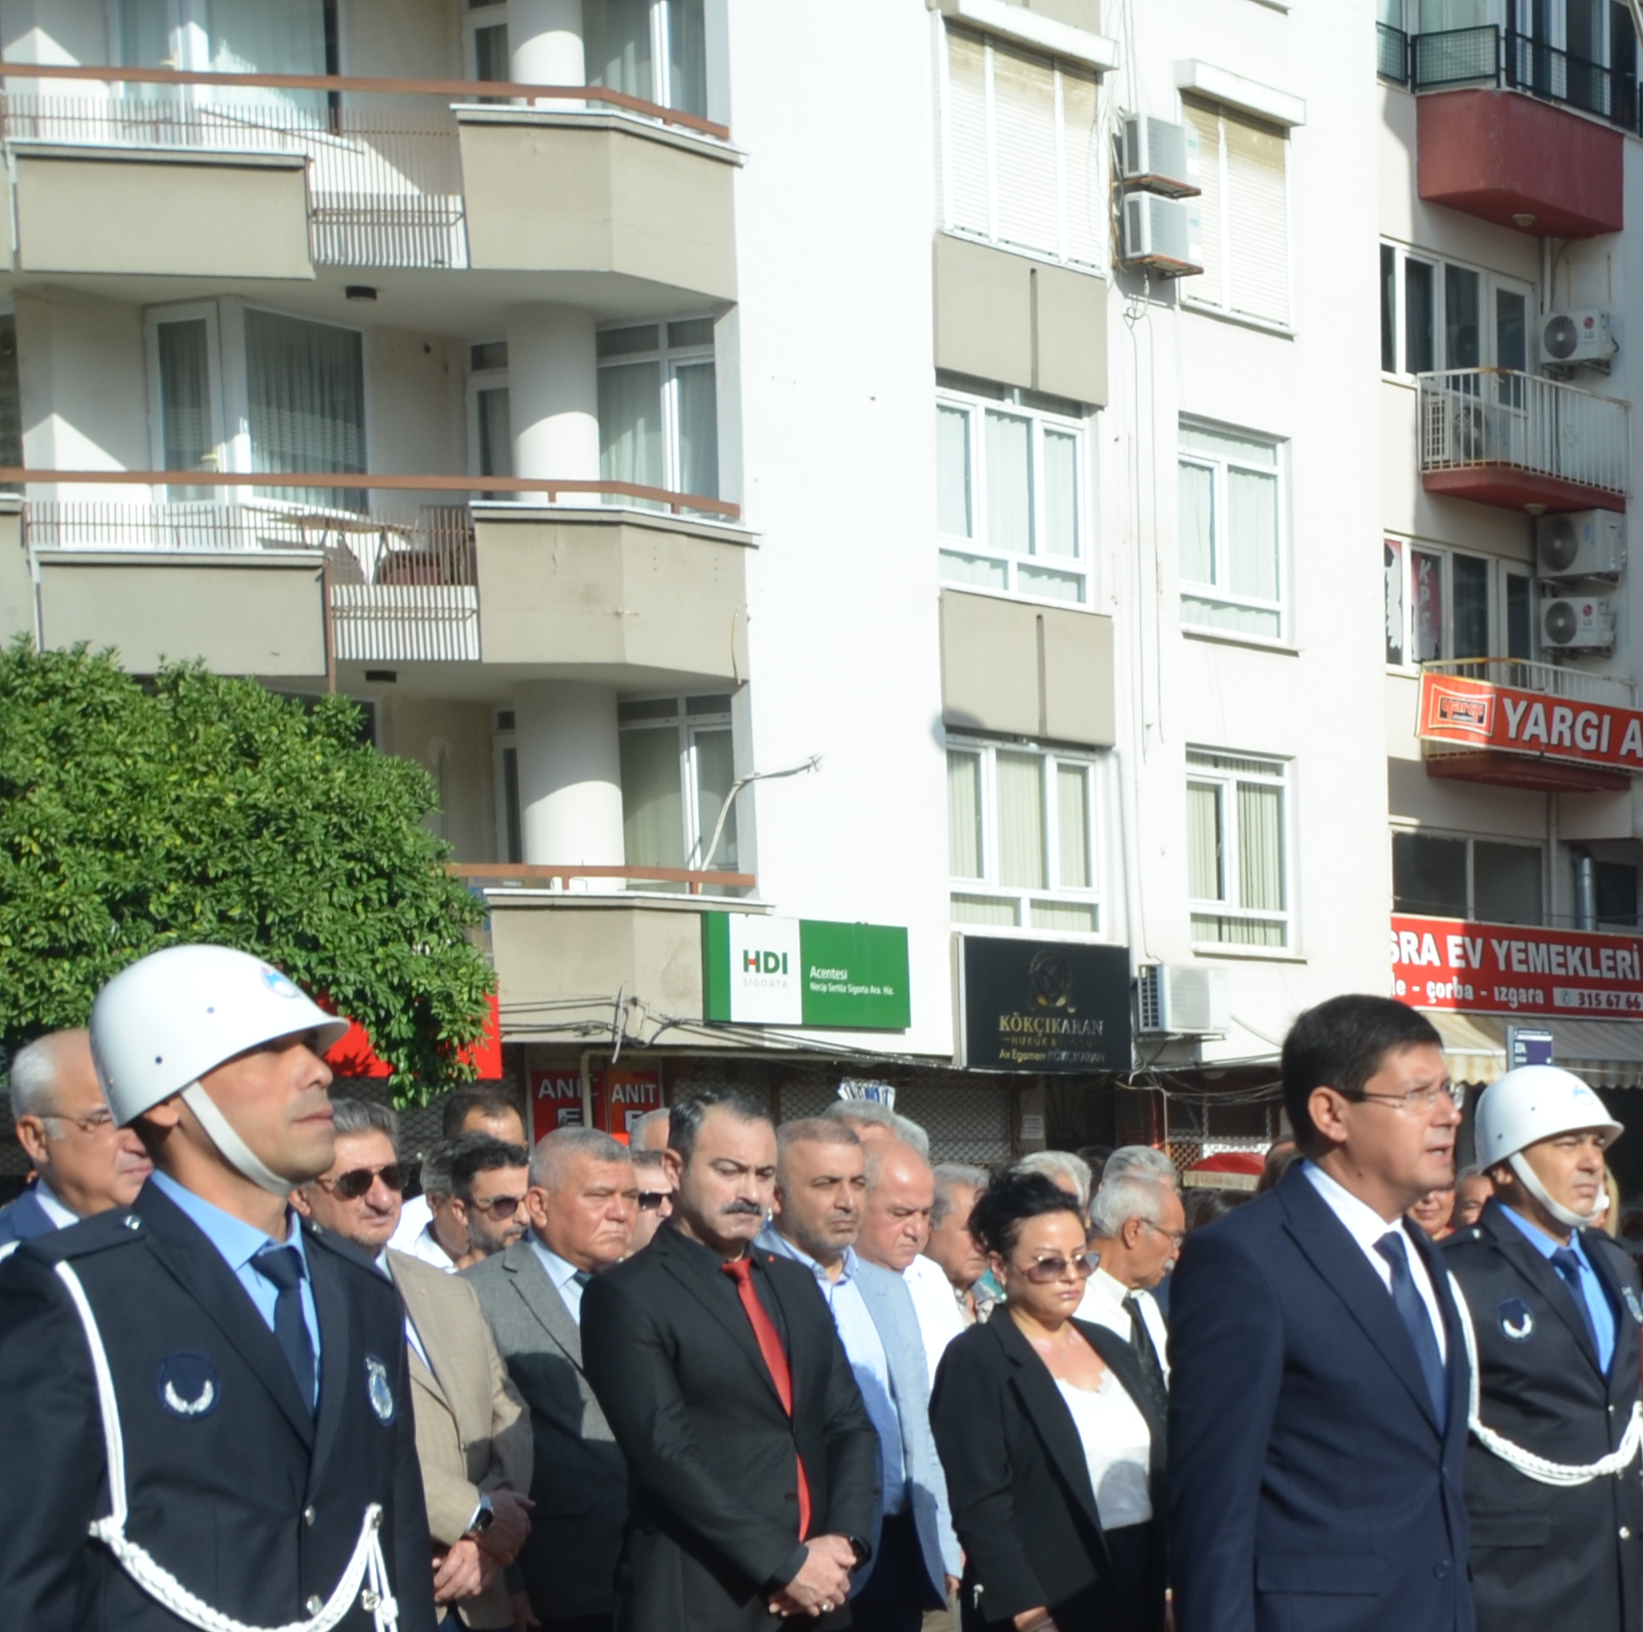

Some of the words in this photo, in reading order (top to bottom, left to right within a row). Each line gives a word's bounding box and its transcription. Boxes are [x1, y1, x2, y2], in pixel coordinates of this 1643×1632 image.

[1502, 696, 1612, 754] YARGI
[742, 949, 789, 975] HDI
[1446, 933, 1484, 970] EV
[1490, 938, 1642, 981] YEMEKLERİ
[809, 965, 848, 981] Acentesi
[1425, 976, 1474, 1004] çorba
[1578, 991, 1603, 1008] 315
[1605, 993, 1621, 1008] 67
[611, 1082, 658, 1105] ANIT
